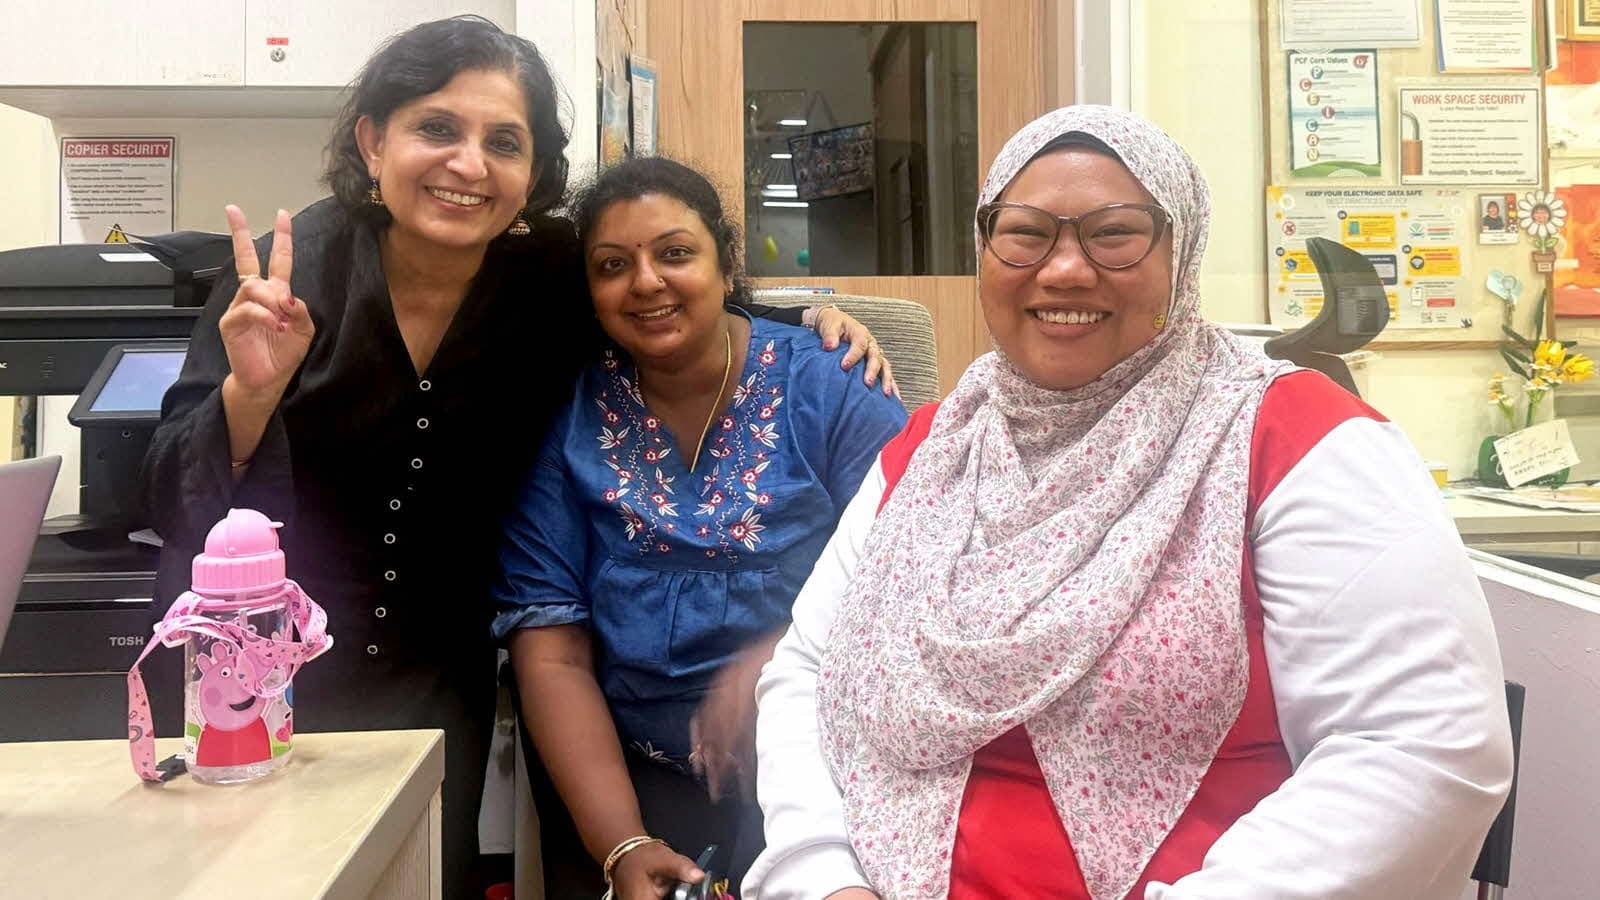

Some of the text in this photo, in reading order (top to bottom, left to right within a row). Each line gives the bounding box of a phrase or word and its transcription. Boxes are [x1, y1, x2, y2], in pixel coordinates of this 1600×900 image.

[1412, 94, 1526, 105] WORK SPACE SECURITY
[66, 144, 169, 156] COPIER SECURITY
[109, 636, 144, 646] TOSH
